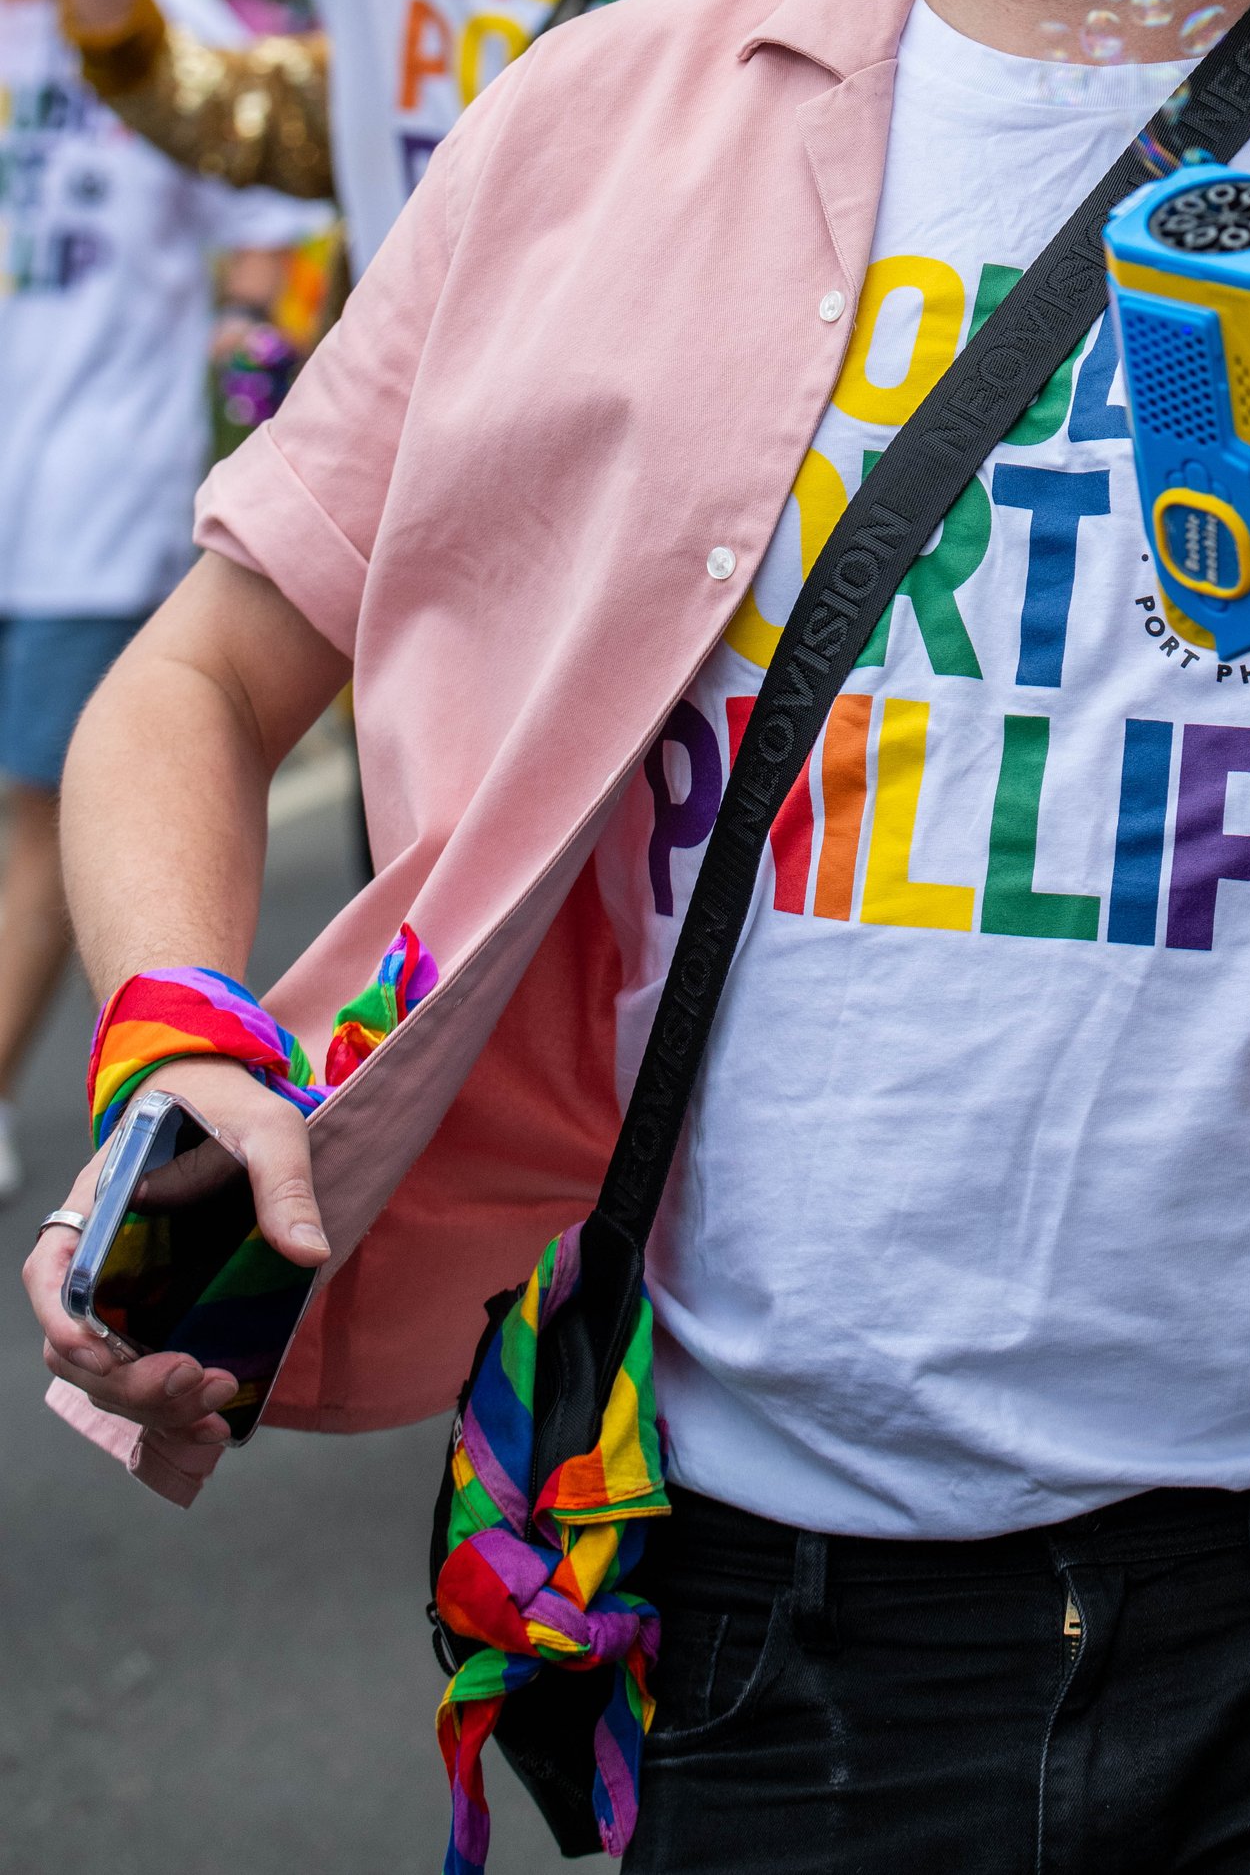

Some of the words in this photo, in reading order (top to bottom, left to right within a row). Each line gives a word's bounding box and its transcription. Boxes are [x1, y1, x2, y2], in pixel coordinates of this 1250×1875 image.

[920, 175, 1142, 458] NEOVISI
[721, 448, 1112, 689] ORT
[1135, 595, 1200, 669] PORT
